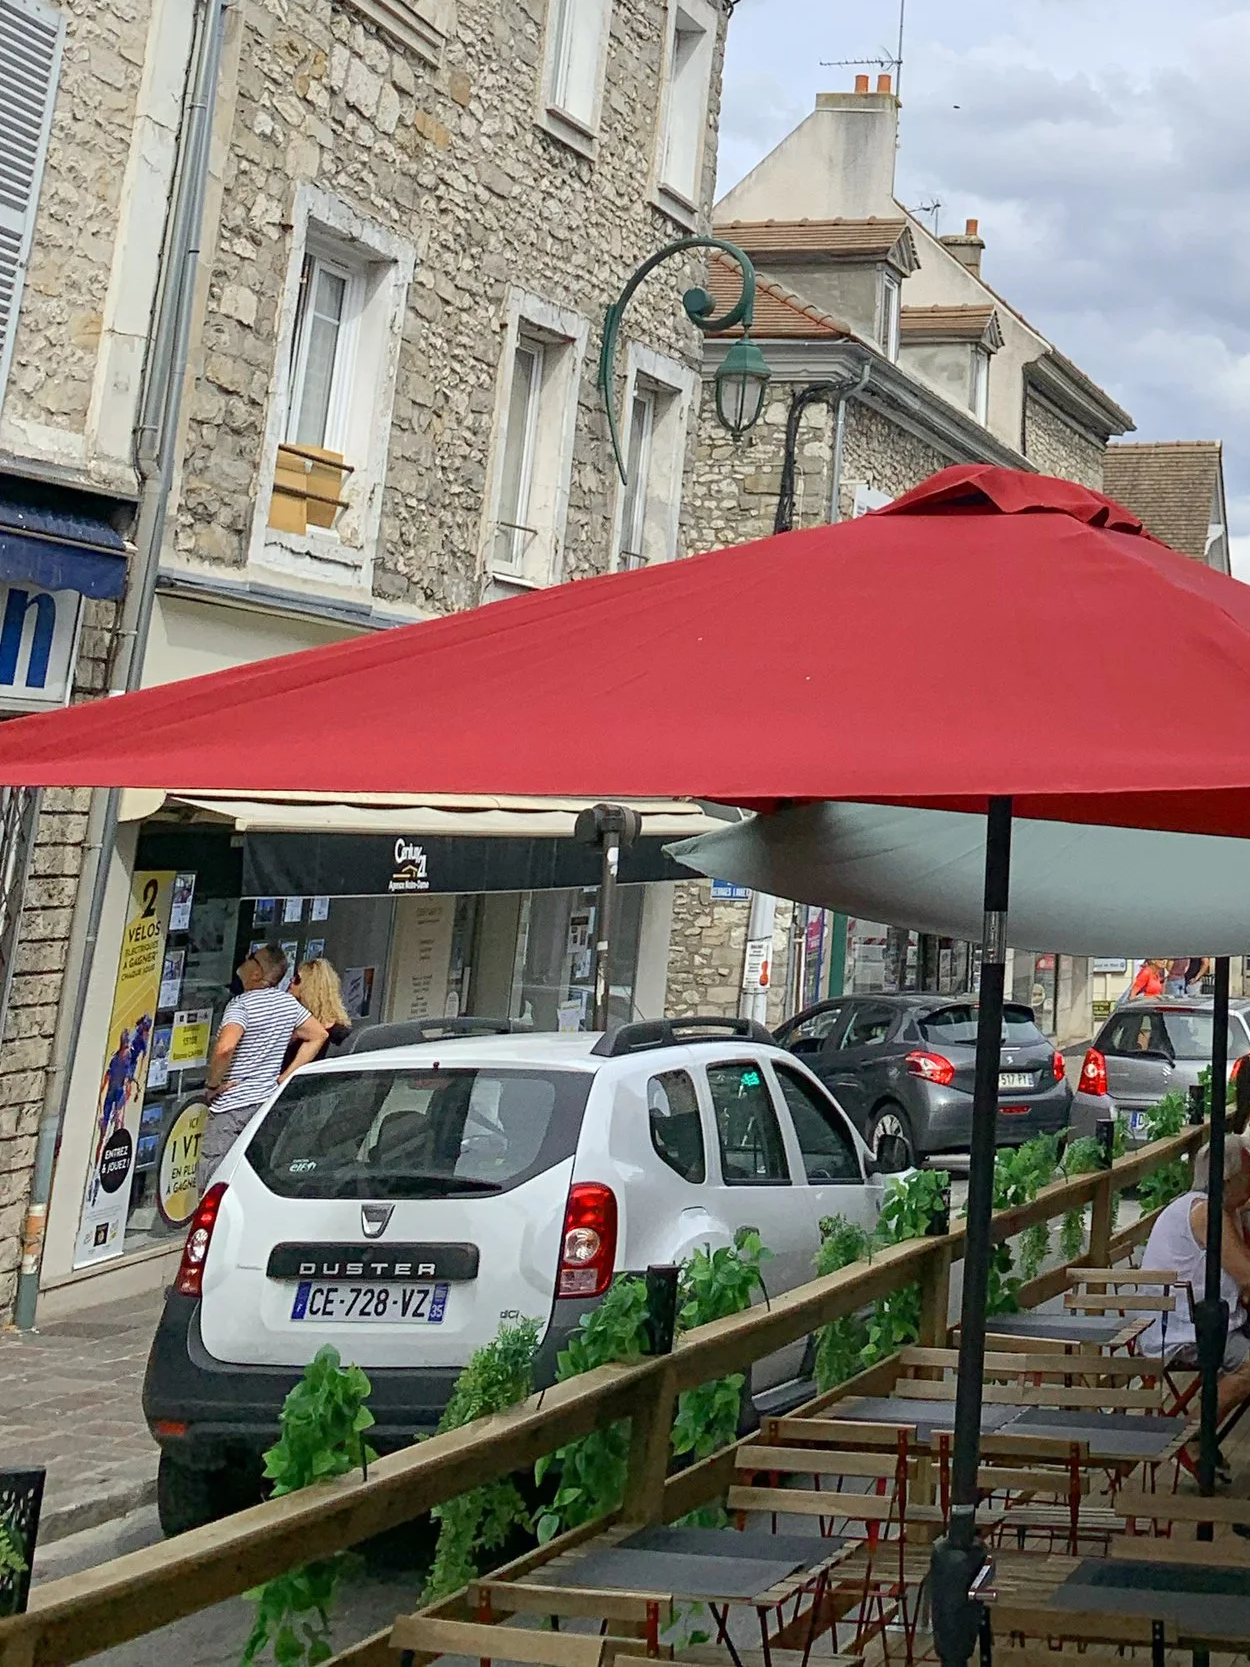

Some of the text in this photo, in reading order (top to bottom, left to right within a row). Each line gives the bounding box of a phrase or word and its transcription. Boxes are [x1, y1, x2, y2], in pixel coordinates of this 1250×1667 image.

[141, 878, 159, 919] 2
[104, 1145, 129, 1160] ENTREZ
[173, 1178, 197, 1194] GAGNE
[300, 1262, 436, 1276] DUSTER
[308, 1287, 430, 1318] CE-728-VZ
[430, 1303, 444, 1319] 35
